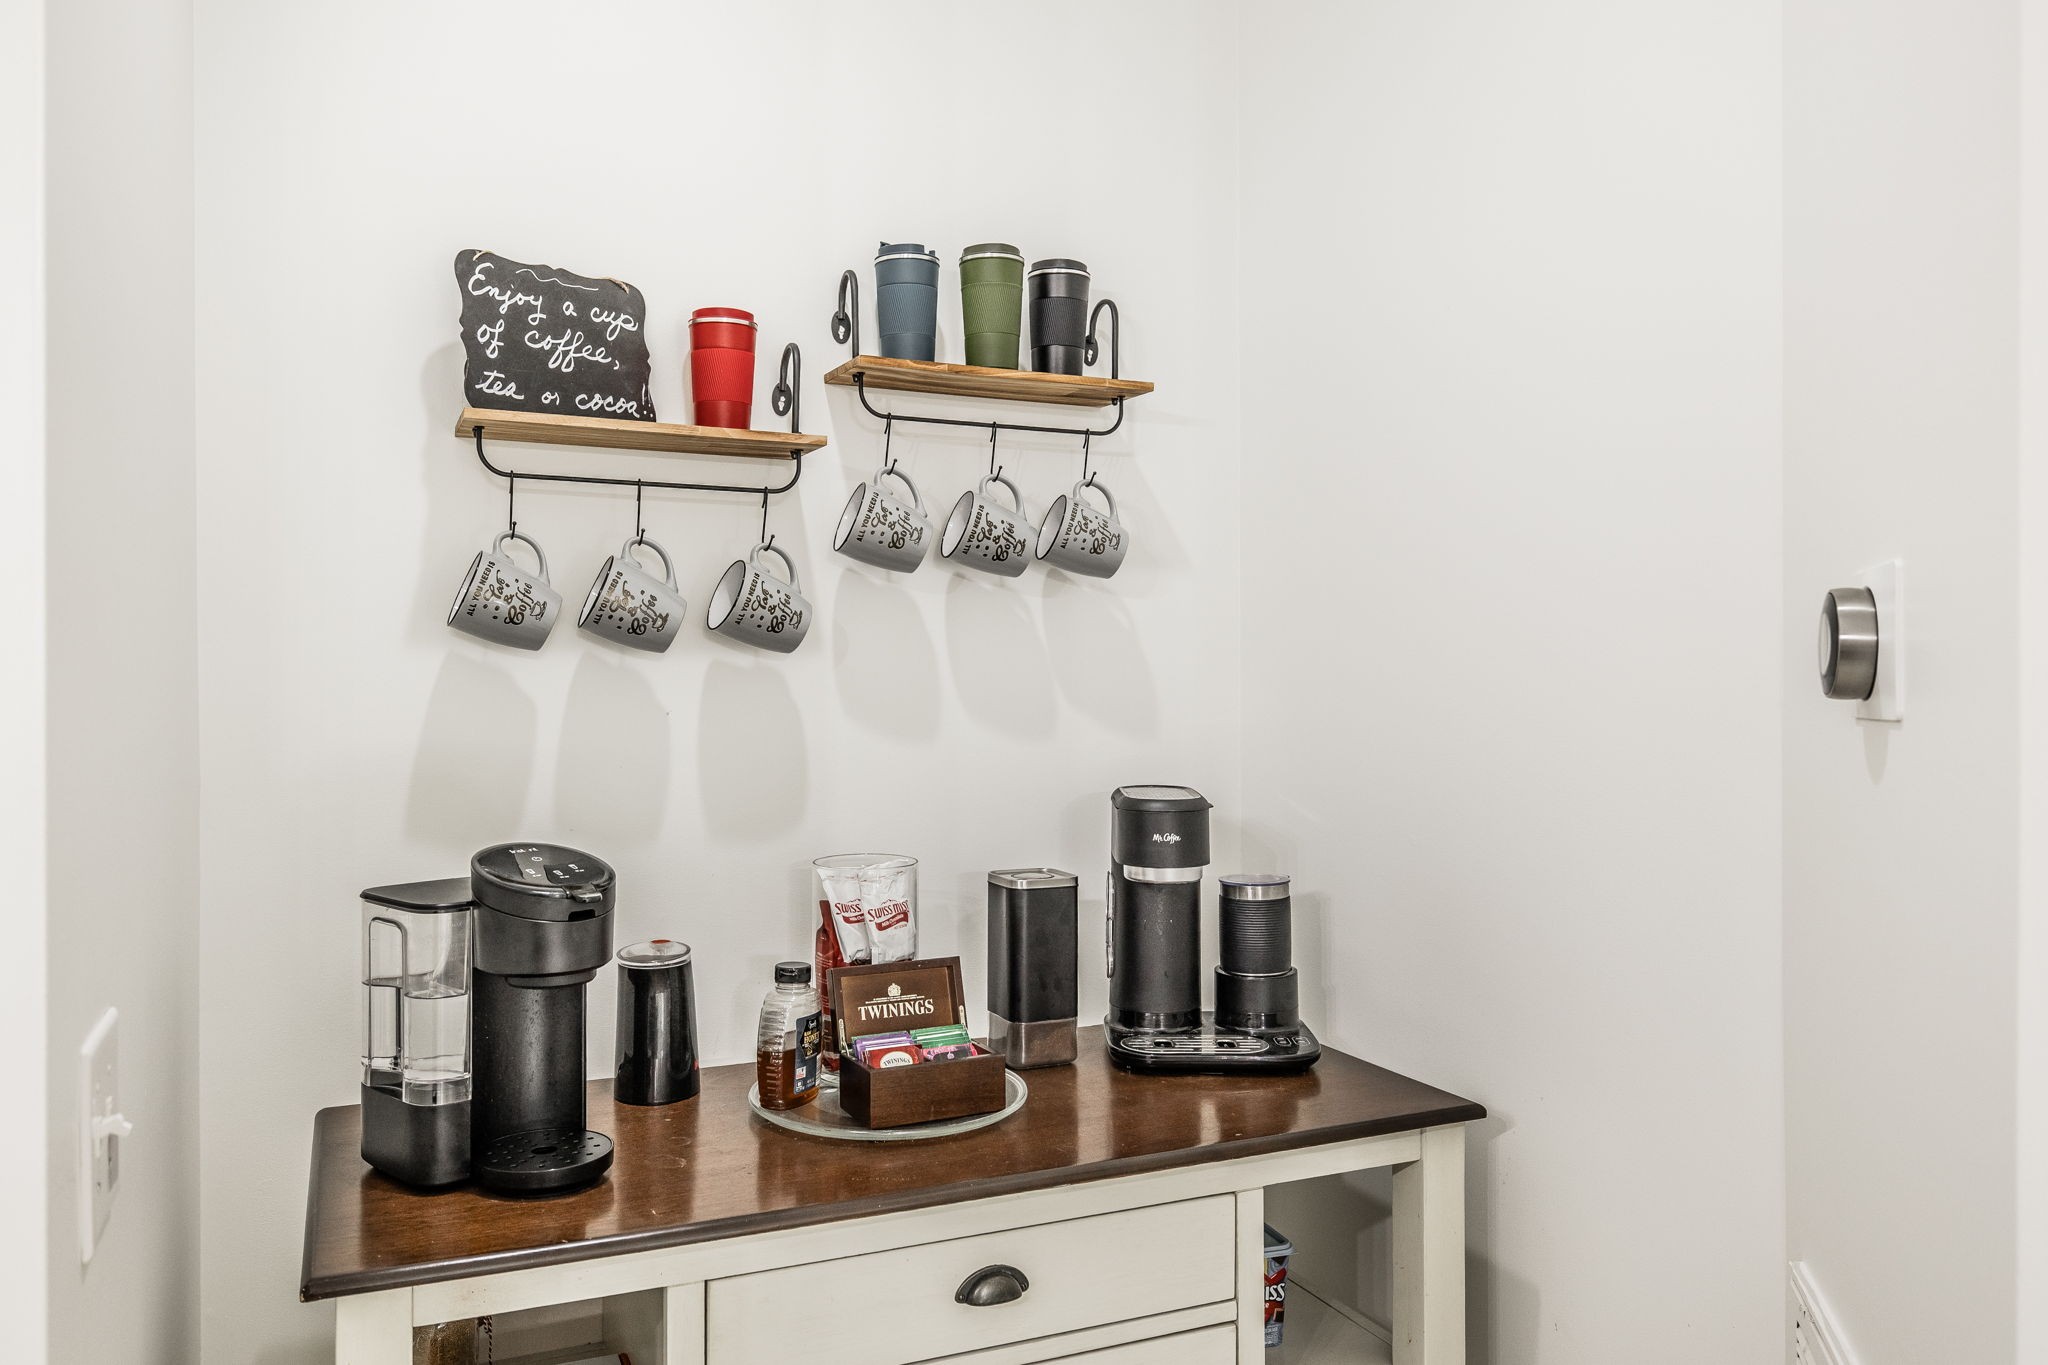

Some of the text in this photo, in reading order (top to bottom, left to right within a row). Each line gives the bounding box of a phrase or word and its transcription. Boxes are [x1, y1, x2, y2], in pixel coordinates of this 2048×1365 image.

[468, 262, 638, 341] Enjoy a cup
[477, 319, 620, 372] of coffee,
[476, 370, 524, 400] tea
[542, 392, 560, 406] or
[856, 529, 866, 543] ALL
[862, 513, 872, 528] YOU
[867, 496, 878, 514] NEED
[962, 544, 972, 555] ALL
[967, 529, 977, 544] YOU
[973, 511, 983, 530] NEED
[1065, 522, 1074, 537] YOU
[1069, 507, 1079, 523] NEED
[1060, 537, 1069, 549] ALL
[467, 603, 477, 616] ALL
[472, 585, 483, 602] YOU
[479, 567, 492, 586] NEED
[735, 613, 746, 625] ALL
[741, 596, 752, 612] YOU
[748, 579, 758, 599] NEED
[593, 613, 603, 625] ALL
[598, 596, 610, 613] YOU
[1163, 833, 1182, 845] Coffee
[858, 998, 934, 1021] TWININGS
